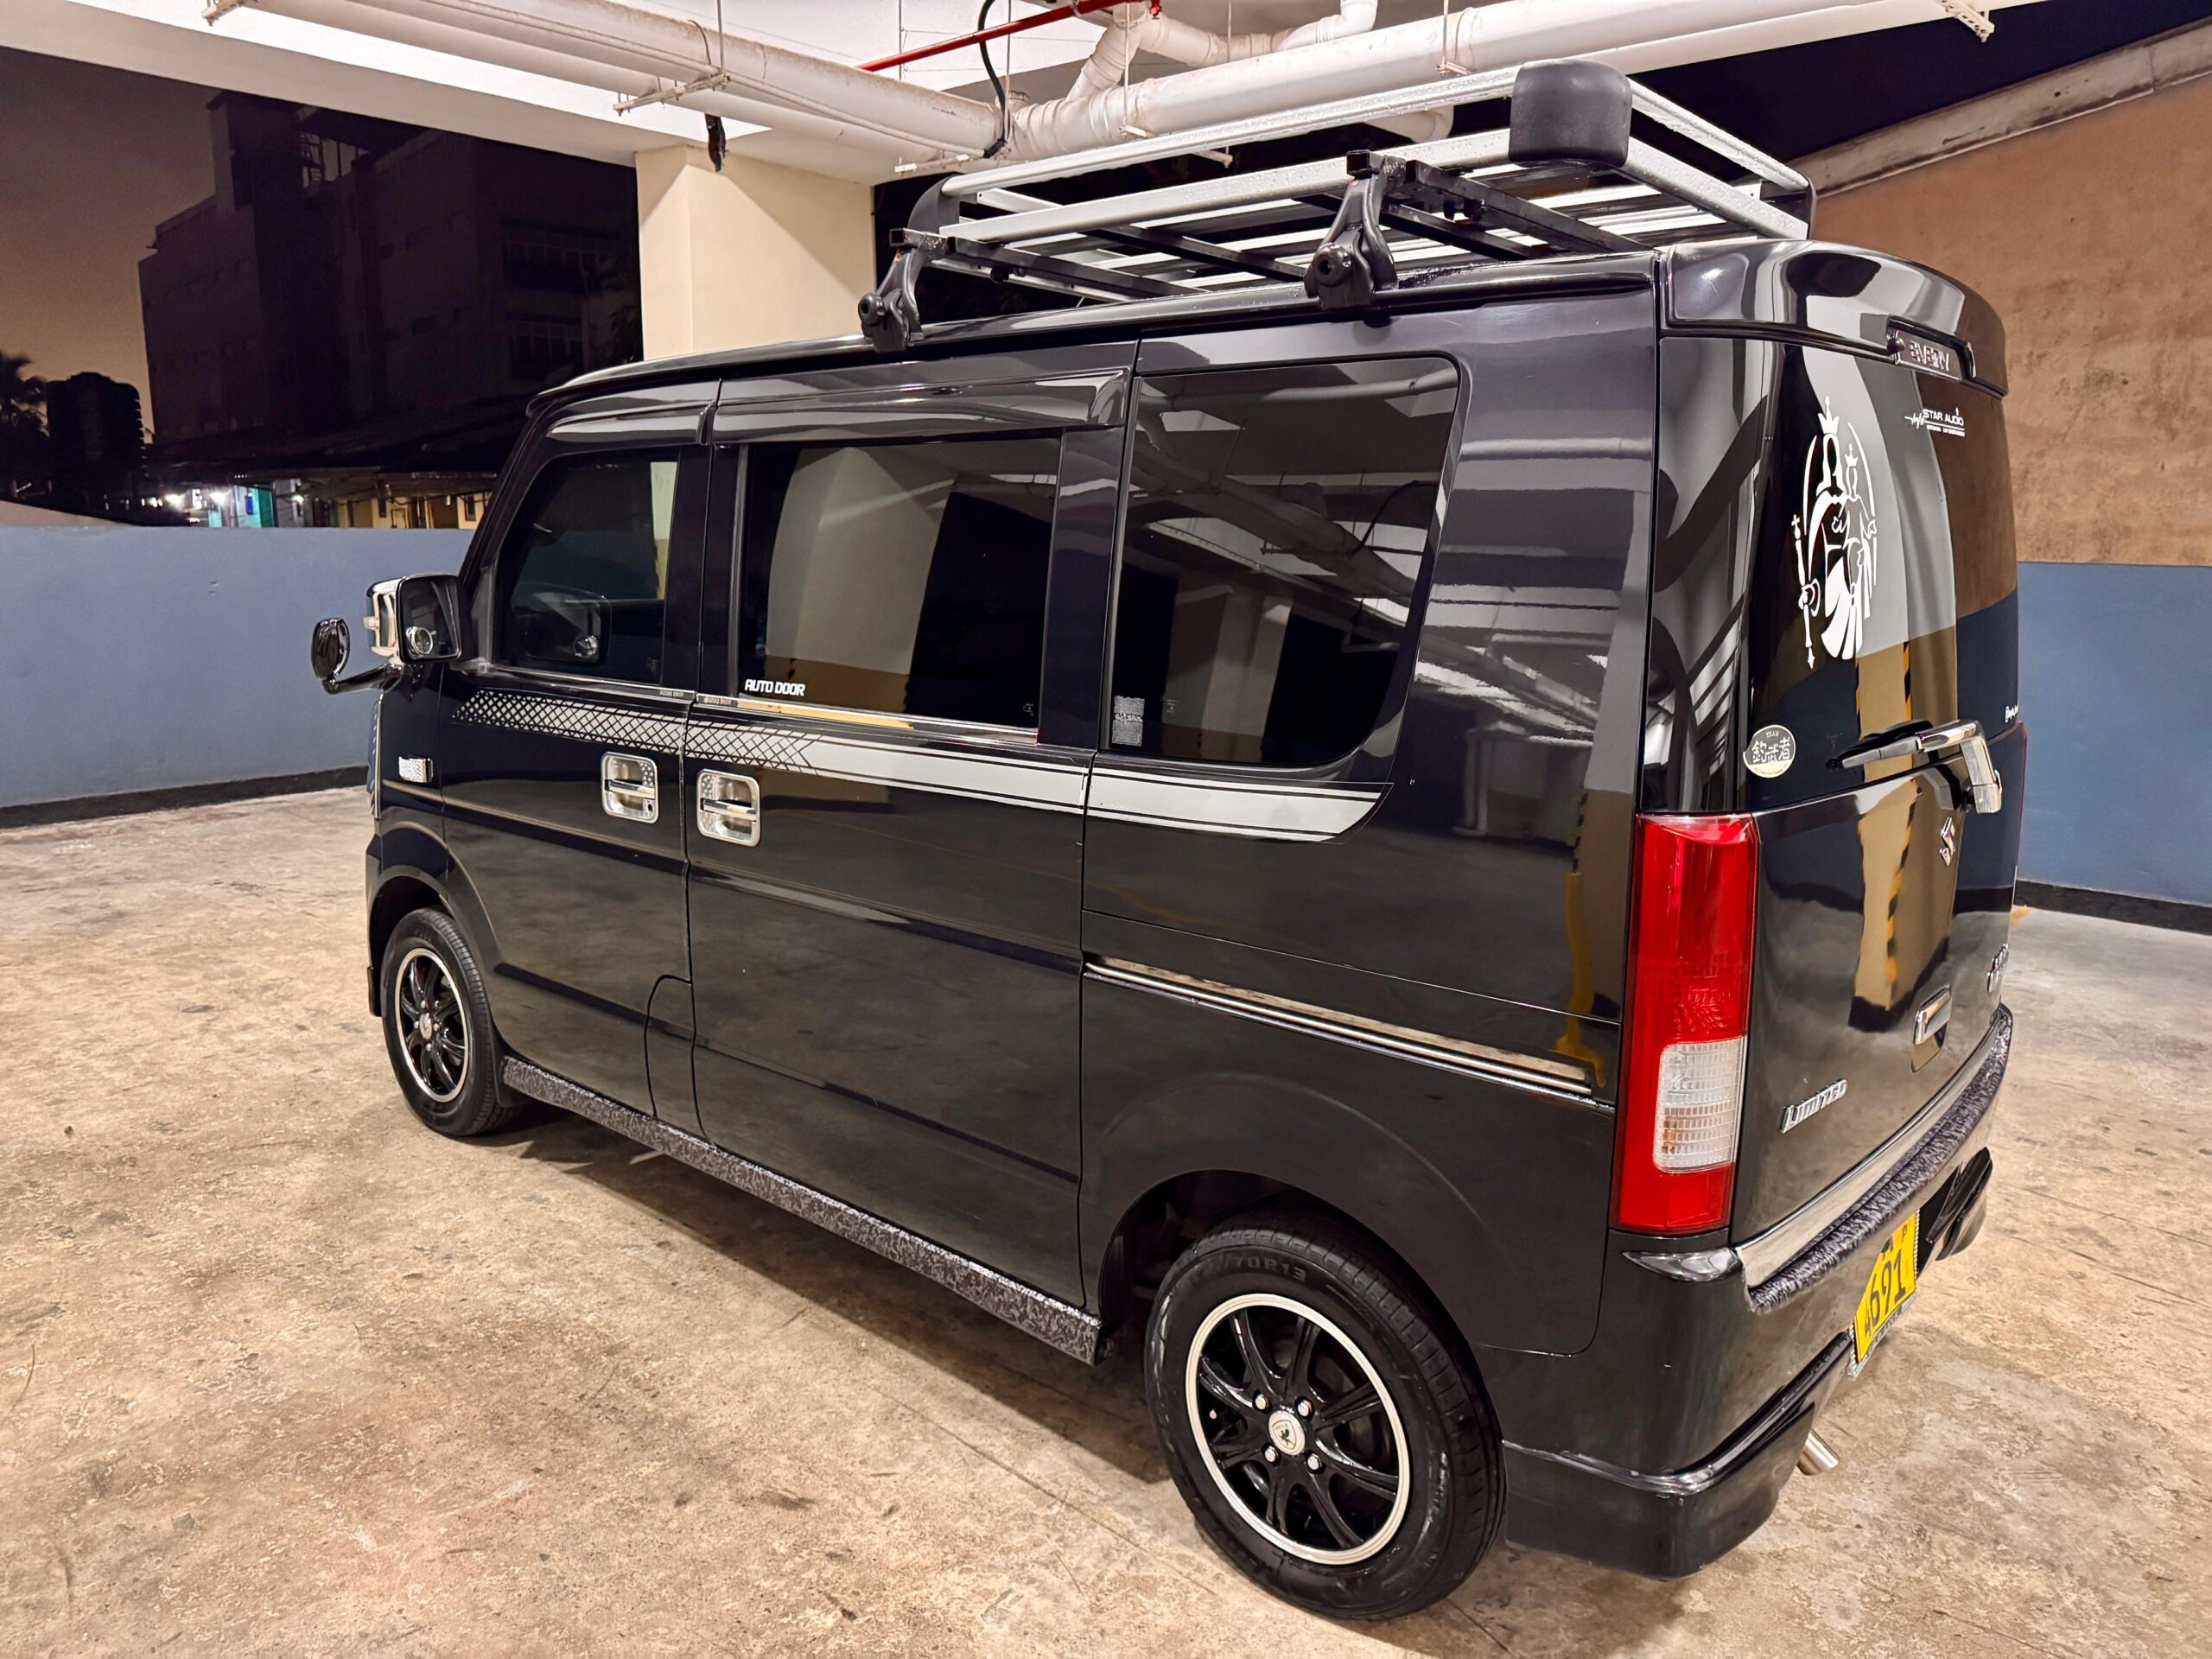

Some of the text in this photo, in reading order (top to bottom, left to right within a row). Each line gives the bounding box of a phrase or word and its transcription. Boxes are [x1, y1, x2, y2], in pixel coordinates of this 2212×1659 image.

[1909, 340, 1949, 372] EVERY
[1923, 408, 1943, 422] STAR
[744, 678, 805, 696] AUTO DOOR
[1765, 729, 1780, 739] TEAM
